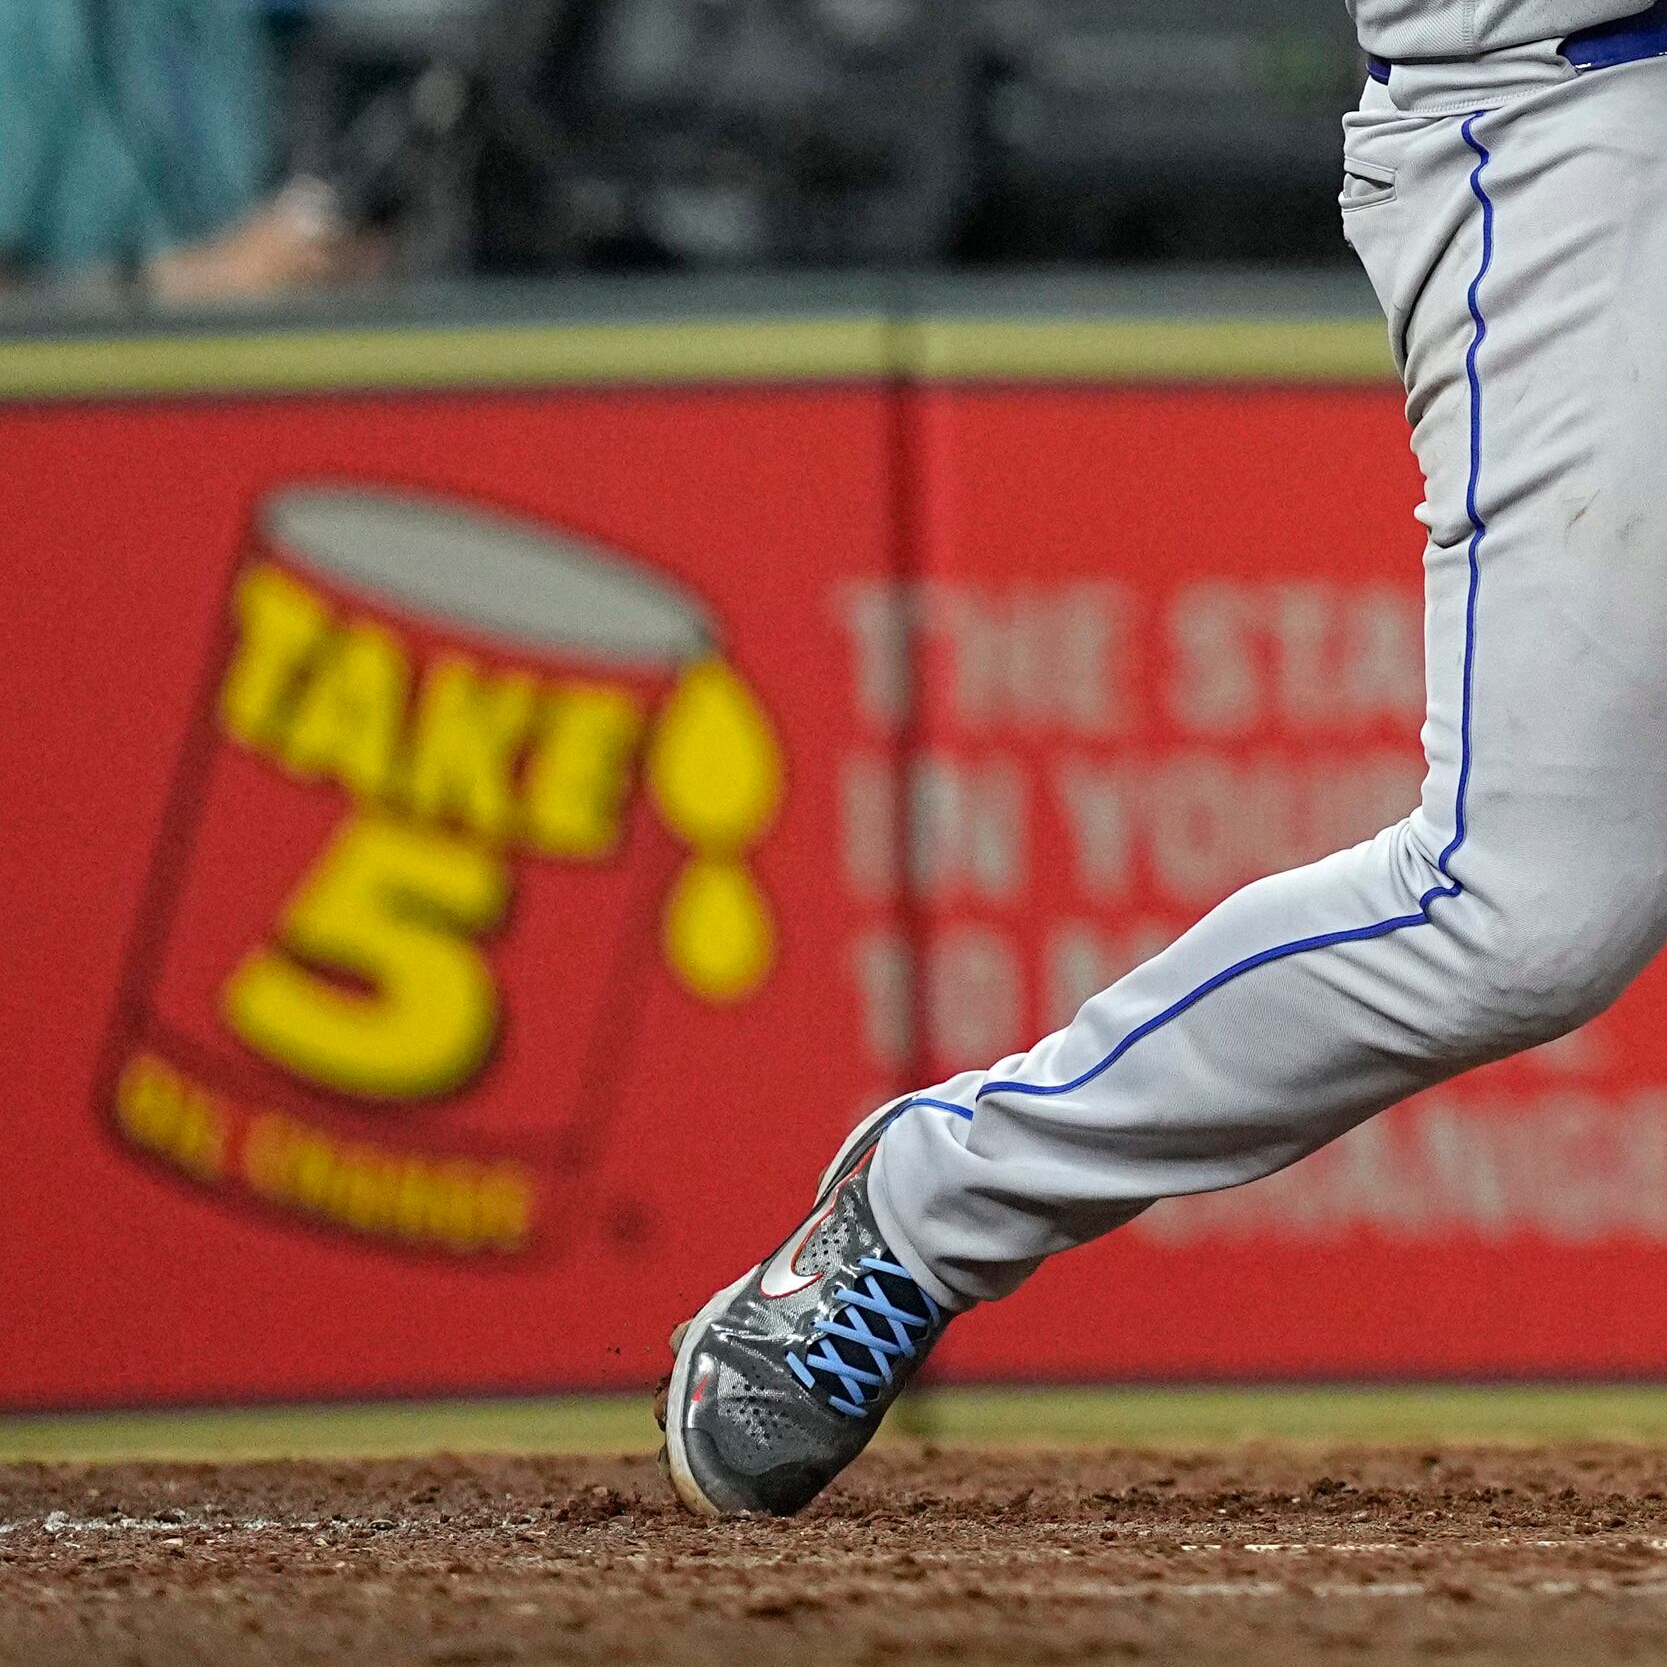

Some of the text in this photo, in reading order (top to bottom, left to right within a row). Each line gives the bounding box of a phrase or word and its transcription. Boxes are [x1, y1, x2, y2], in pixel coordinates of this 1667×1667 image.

[219, 561, 645, 859] TAKE
[832, 576, 1424, 733] THE STA
[222, 805, 511, 1098] 5
